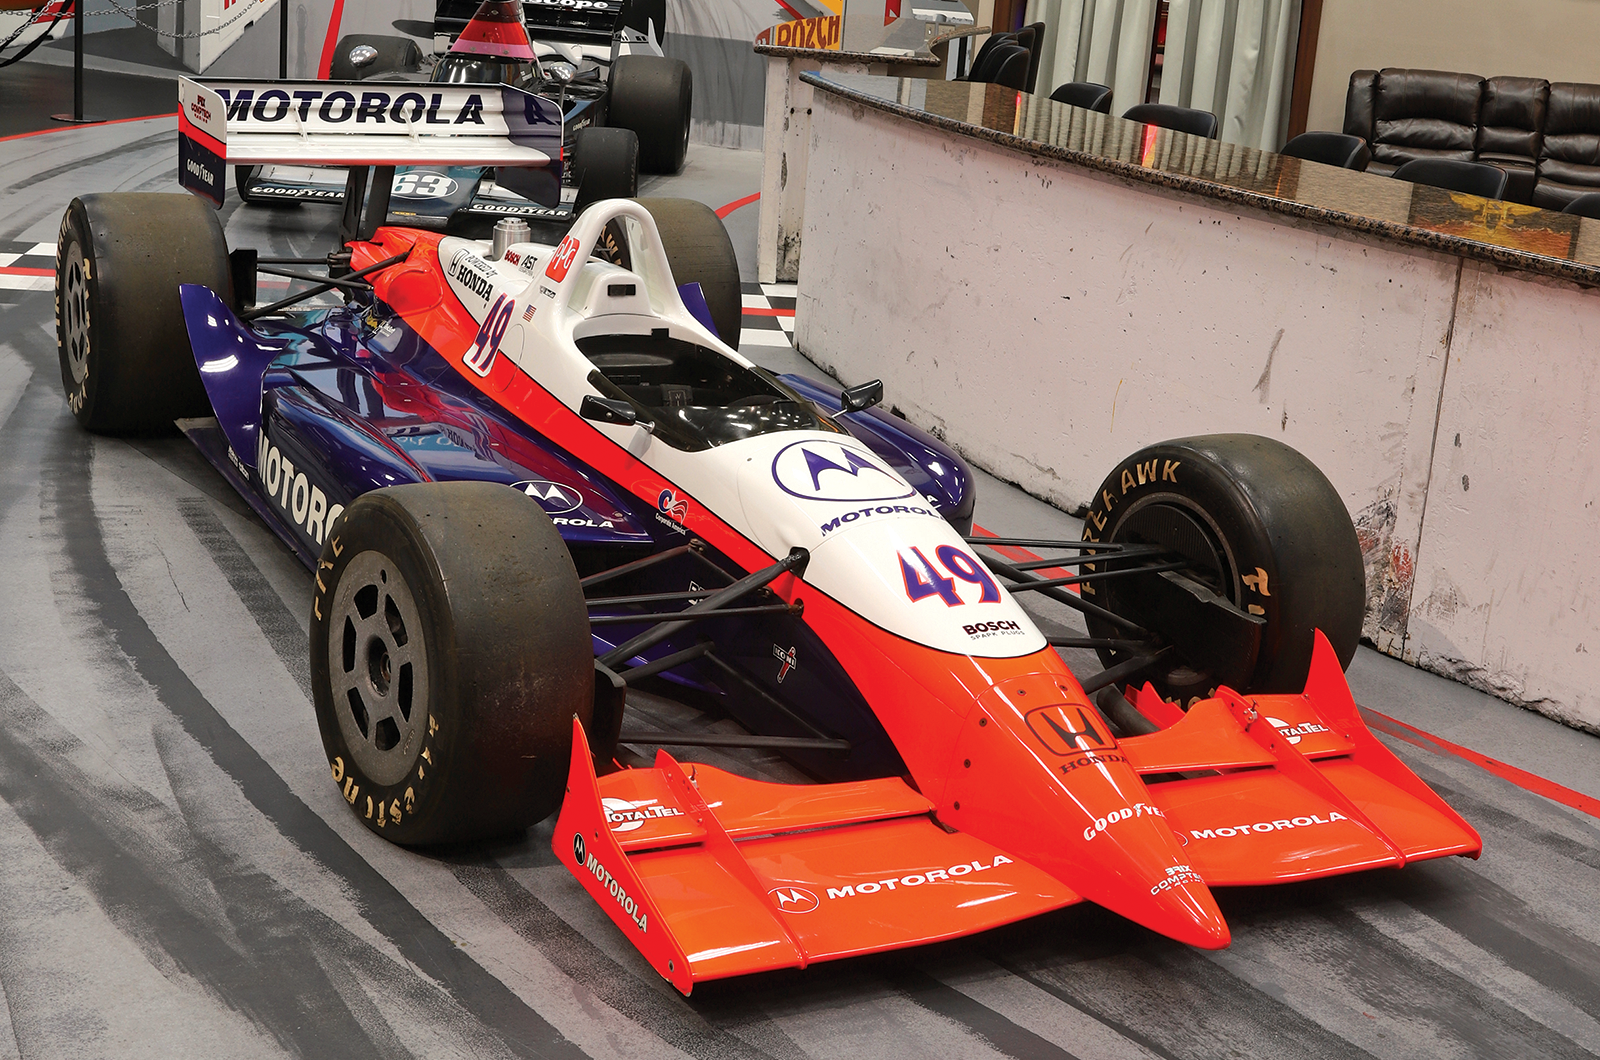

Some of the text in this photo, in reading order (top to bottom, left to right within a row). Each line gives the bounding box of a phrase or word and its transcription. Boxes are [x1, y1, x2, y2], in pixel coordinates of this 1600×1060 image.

[214, 89, 485, 126] MOTOROLA
[187, 158, 215, 187] GOODYEAR
[391, 174, 452, 196] 63
[250, 186, 346, 199] GOODYEAR
[472, 203, 569, 217] GOODYEAR
[504, 249, 522, 267] BOSCH
[521, 254, 538, 271] AST
[551, 236, 577, 271] PPG
[456, 264, 494, 302] HONDA
[470, 292, 515, 372] 49
[551, 516, 615, 529] ROLA
[820, 505, 944, 537] MOTOROL
[896, 544, 1001, 607] 49
[962, 620, 1021, 636] BOSCH
[970, 629, 1026, 641] SPARK PLUGS
[775, 647, 796, 668] KONI
[1059, 754, 1133, 776] HONDA
[1083, 803, 1168, 841] GOODYE
[1190, 811, 1348, 840] MOTOROLA
[826, 854, 1014, 900] MOTOROLA
[586, 852, 647, 933] MOTOROLA
